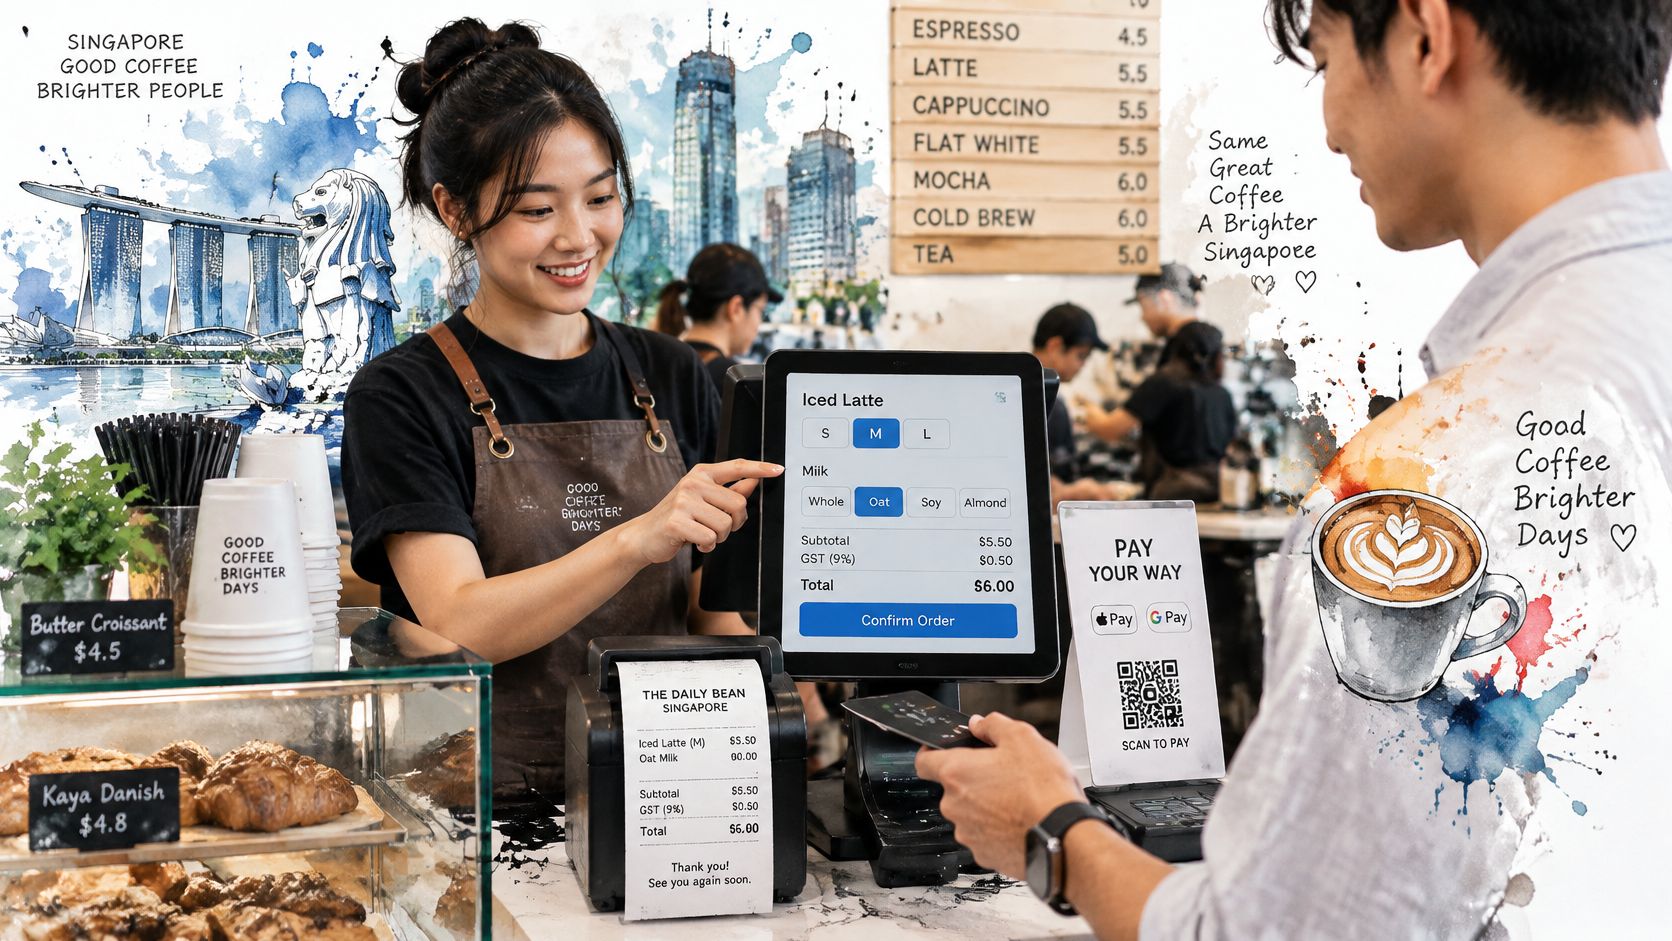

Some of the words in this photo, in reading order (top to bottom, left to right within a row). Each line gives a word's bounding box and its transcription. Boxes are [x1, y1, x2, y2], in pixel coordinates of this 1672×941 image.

[914, 19, 1019, 41] ESPRESSO
[1118, 28, 1147, 46] 4.5
[914, 58, 977, 77] LATTE
[1119, 64, 1147, 83] 5.5
[913, 95, 1049, 116] CAPPUCCINO
[1119, 101, 1147, 119] 5.5
[914, 133, 965, 152] FLAT
[974, 135, 1038, 154] WHITE
[1119, 137, 1147, 156] 5.5
[914, 171, 990, 189] MOCHA
[1118, 172, 1147, 191] 6.0
[914, 208, 969, 226] COLD
[978, 209, 1035, 227] BREW
[1118, 209, 1147, 228] 6.0
[914, 245, 953, 263] TEA
[1119, 245, 1148, 265] 5.0
[804, 393, 836, 406] Iced
[843, 394, 883, 407] Latte
[822, 428, 829, 438] S
[871, 428, 881, 439] M
[924, 429, 931, 439] L
[809, 497, 844, 506] Whole
[870, 497, 889, 506] Oat
[922, 498, 941, 509] Soy
[964, 498, 1006, 507] Almond
[572, 521, 600, 531] DAYS
[224, 537, 264, 548] GOOD
[802, 535, 849, 545] Subtotal
[980, 537, 1012, 547] $5.50
[1115, 539, 1152, 557] PAY
[222, 552, 273, 564] COFFEE
[801, 553, 825, 563] GST
[830, 554, 855, 565] (9%)
[980, 555, 1013, 565] $0.50
[221, 567, 285, 580] BRIGHTER
[1089, 566, 1138, 581] YOUR
[1143, 565, 1181, 580] WAY
[224, 582, 258, 595] DAYS
[801, 579, 833, 590] Total
[975, 580, 1014, 592] $6.00
[31, 614, 84, 635] Butter
[92, 613, 167, 632] Croissant
[862, 615, 913, 626] Confirm
[918, 615, 955, 626] Order
[1110, 613, 1132, 628] Pay
[1166, 611, 1187, 626] Pay
[75, 641, 120, 663] $4.5
[643, 690, 667, 699] THE
[672, 689, 707, 699] DAILY
[712, 689, 745, 698] BEAN
[663, 703, 728, 713] SINGAPORE
[639, 739, 658, 748] Iced
[662, 739, 686, 747] Latte
[690, 738, 705, 749] (M)
[1122, 740, 1150, 750] SCAN
[1153, 739, 1167, 748] TO
[1171, 738, 1189, 747] PAY
[640, 754, 656, 763] Oat
[43, 785, 91, 814] Kaya
[101, 781, 164, 803] Danish
[640, 789, 679, 798] Subtotal
[640, 805, 659, 814] GST
[663, 805, 684, 815] (9%)
[80, 813, 127, 837] $4.8
[640, 826, 666, 836] Total
[672, 862, 703, 872] Thank
[707, 861, 729, 874] you!
[649, 879, 667, 888] See
[671, 879, 689, 889] you
[693, 875, 720, 888] again
